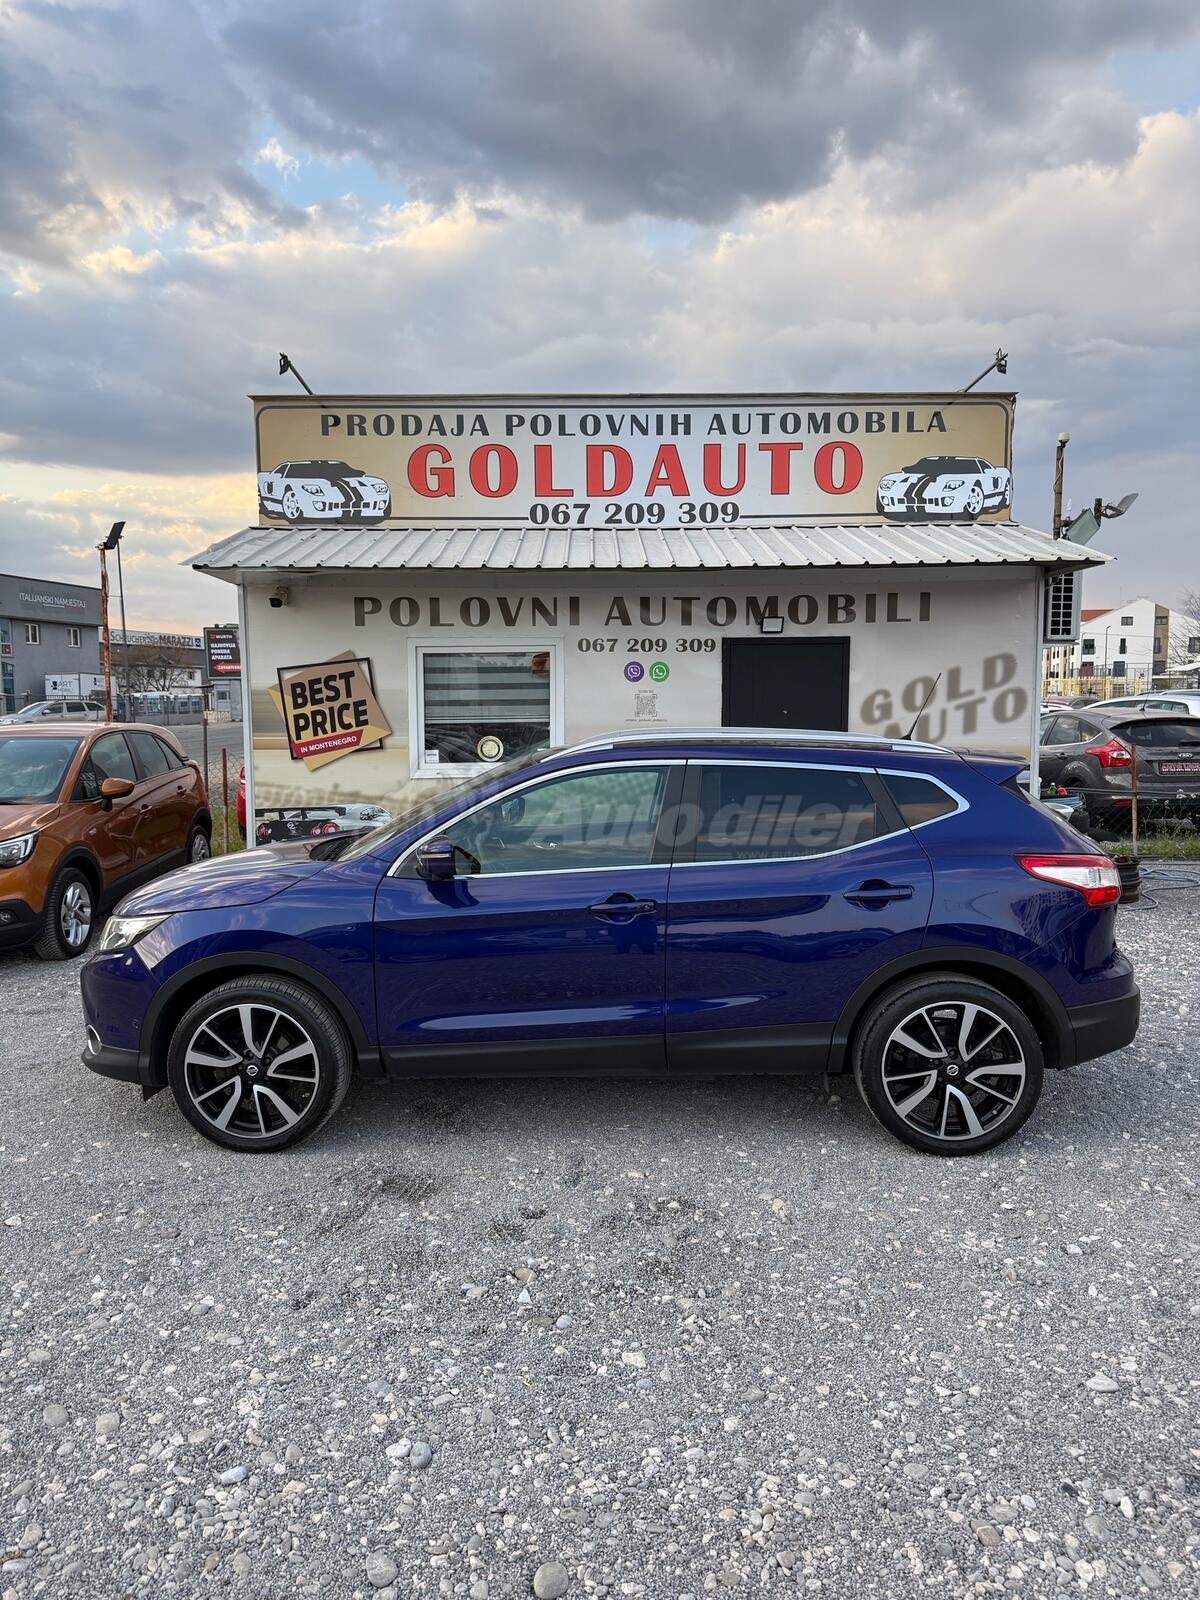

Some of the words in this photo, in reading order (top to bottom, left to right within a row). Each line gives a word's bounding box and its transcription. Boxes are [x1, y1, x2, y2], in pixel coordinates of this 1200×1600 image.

[320, 413, 490, 437] PRODAJA
[505, 412, 692, 437] POLOVNIH
[707, 410, 948, 436] AUTOMOBILA
[407, 441, 864, 498] GOLDAUTO
[529, 503, 592, 525] 067
[604, 502, 666, 525] 209
[677, 502, 740, 524] 309
[353, 596, 580, 627] POLOVNI
[604, 592, 931, 627] AUTOMOBILI
[159, 634, 194, 647] MARAZZI
[577, 638, 619, 653] 067
[626, 638, 668, 653] 209
[675, 638, 717, 653] 309
[290, 670, 355, 711] BEST
[860, 653, 1018, 726] GOLD
[293, 699, 369, 741] PRICE
[883, 686, 1028, 744] AUTO
[300, 746, 308, 754] IN
[309, 735, 358, 752] MONTENEGRO
